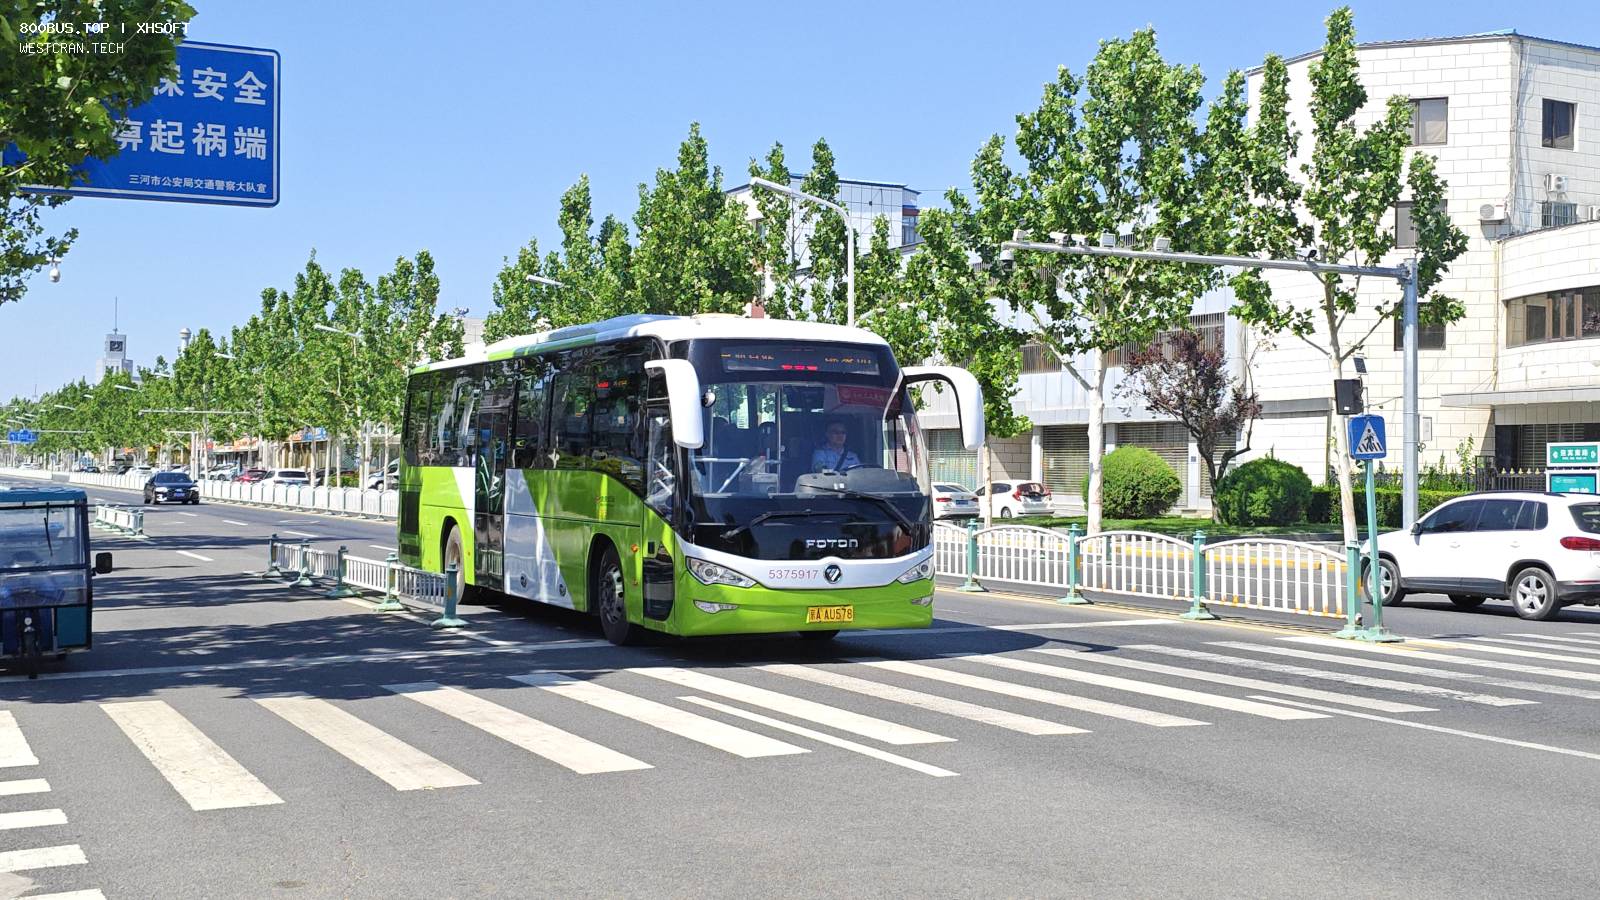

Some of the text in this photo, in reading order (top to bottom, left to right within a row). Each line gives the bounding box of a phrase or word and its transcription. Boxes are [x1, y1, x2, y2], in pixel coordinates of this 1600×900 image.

[128, 174, 268, 194] 三河市公安局交通警察大队宣
[806, 539, 859, 549] FOTON
[768, 570, 819, 579] 5375917
